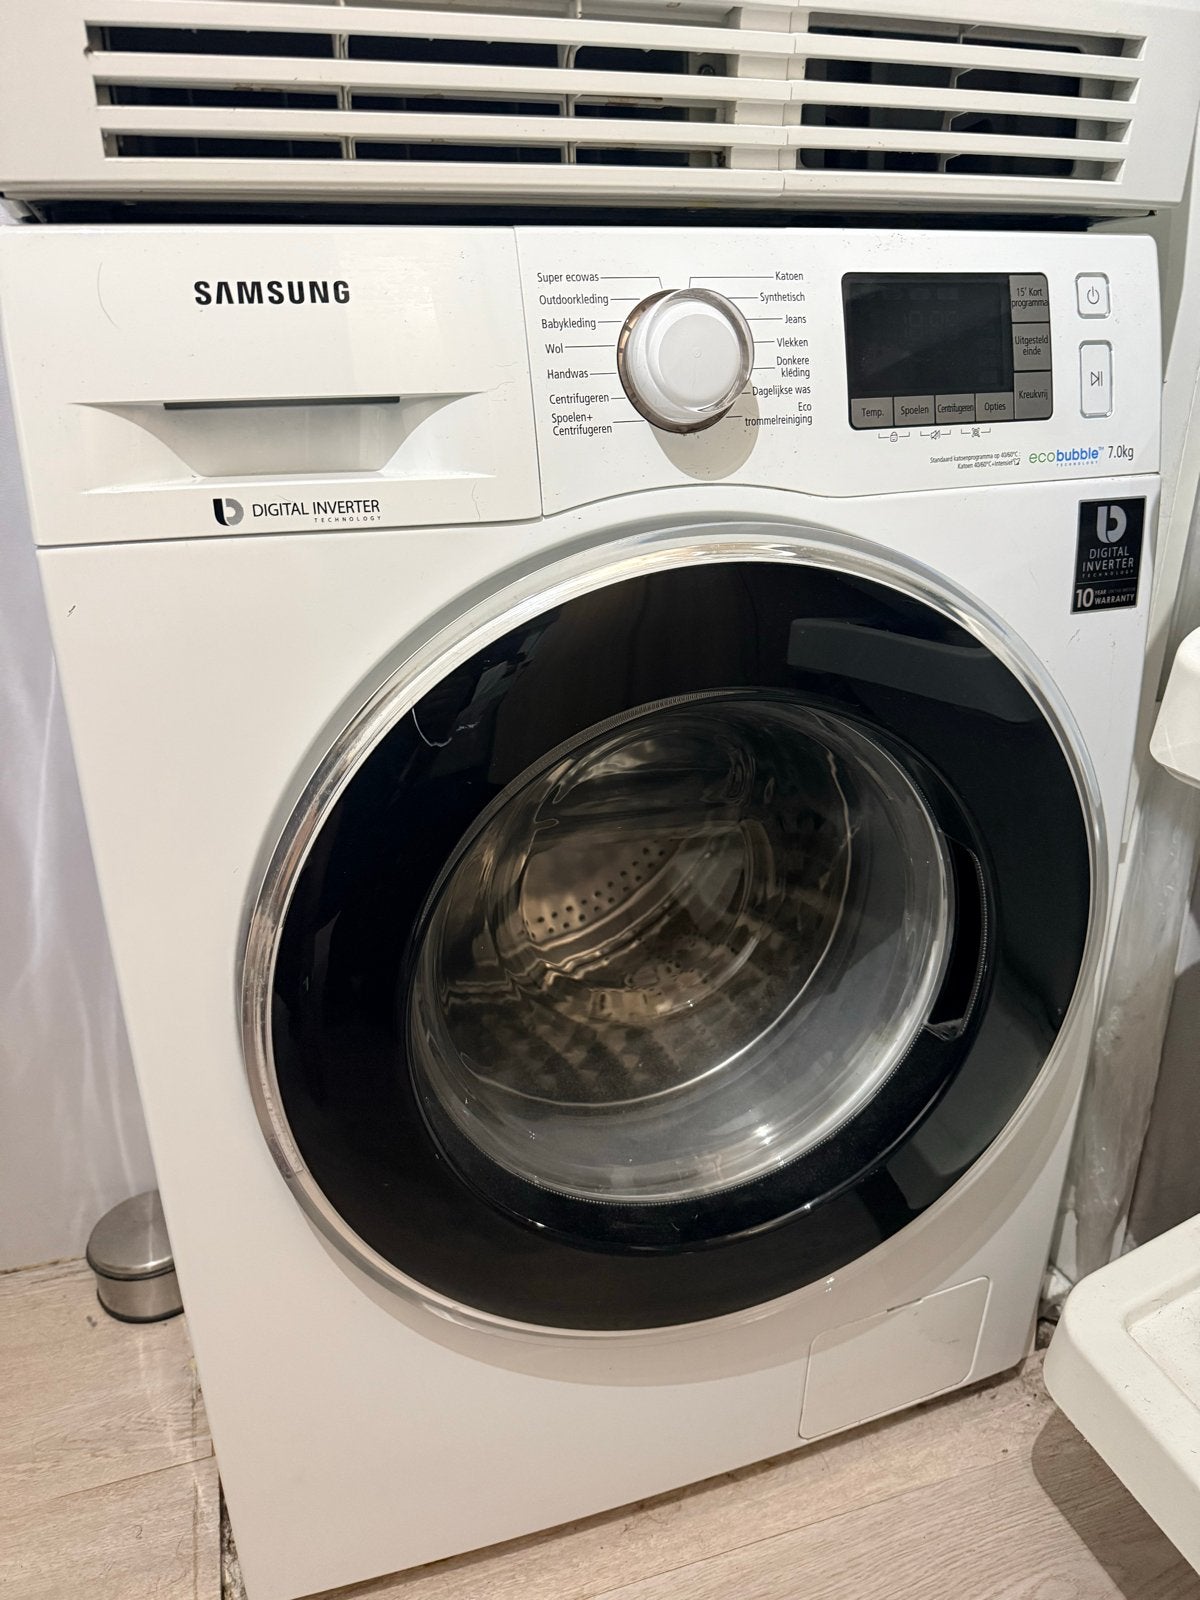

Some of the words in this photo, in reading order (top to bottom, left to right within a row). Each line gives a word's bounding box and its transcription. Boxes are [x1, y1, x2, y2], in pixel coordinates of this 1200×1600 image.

[537, 273, 563, 283] Super
[566, 273, 599, 282] ecowas
[775, 271, 804, 281] Katoen
[194, 281, 350, 305] SAMSUNG
[760, 292, 805, 303] Synthetisch
[1029, 287, 1043, 297] Kort
[539, 294, 609, 305] Outdoorkleding
[1012, 299, 1049, 309] programma
[541, 318, 596, 330] Babykleding
[785, 314, 807, 324] Jeans
[777, 337, 809, 348] Vlekken
[1015, 335, 1049, 347] Uitgesteld
[545, 343, 564, 354] Wol
[1022, 346, 1042, 356] einde
[777, 355, 810, 367] Donkere
[547, 368, 589, 379] Handwas
[752, 385, 793, 398] Dagelijkse
[795, 386, 811, 395] was
[1018, 389, 1049, 401] Kreukvrij
[549, 393, 610, 406] Centrifugeren
[798, 402, 812, 412] Eco
[900, 405, 930, 417] Spoelen
[937, 403, 974, 415] Centrifugeren
[984, 400, 1007, 412] Opties
[551, 412, 593, 425] Spoelen+
[862, 407, 885, 418] Temp.
[745, 413, 813, 427] trommelreiniging
[553, 424, 613, 437] Centrifugeren
[1108, 445, 1134, 461] 7.0kg
[252, 501, 309, 518] DIGITAL
[313, 500, 380, 515] INVERTER
[1089, 546, 1130, 559] DIGITAL
[1082, 558, 1134, 572] INVERTER
[1082, 569, 1134, 578] TECHNOLOGY
[1076, 588, 1094, 608] 10
[1094, 593, 1135, 605] WARRANTY
